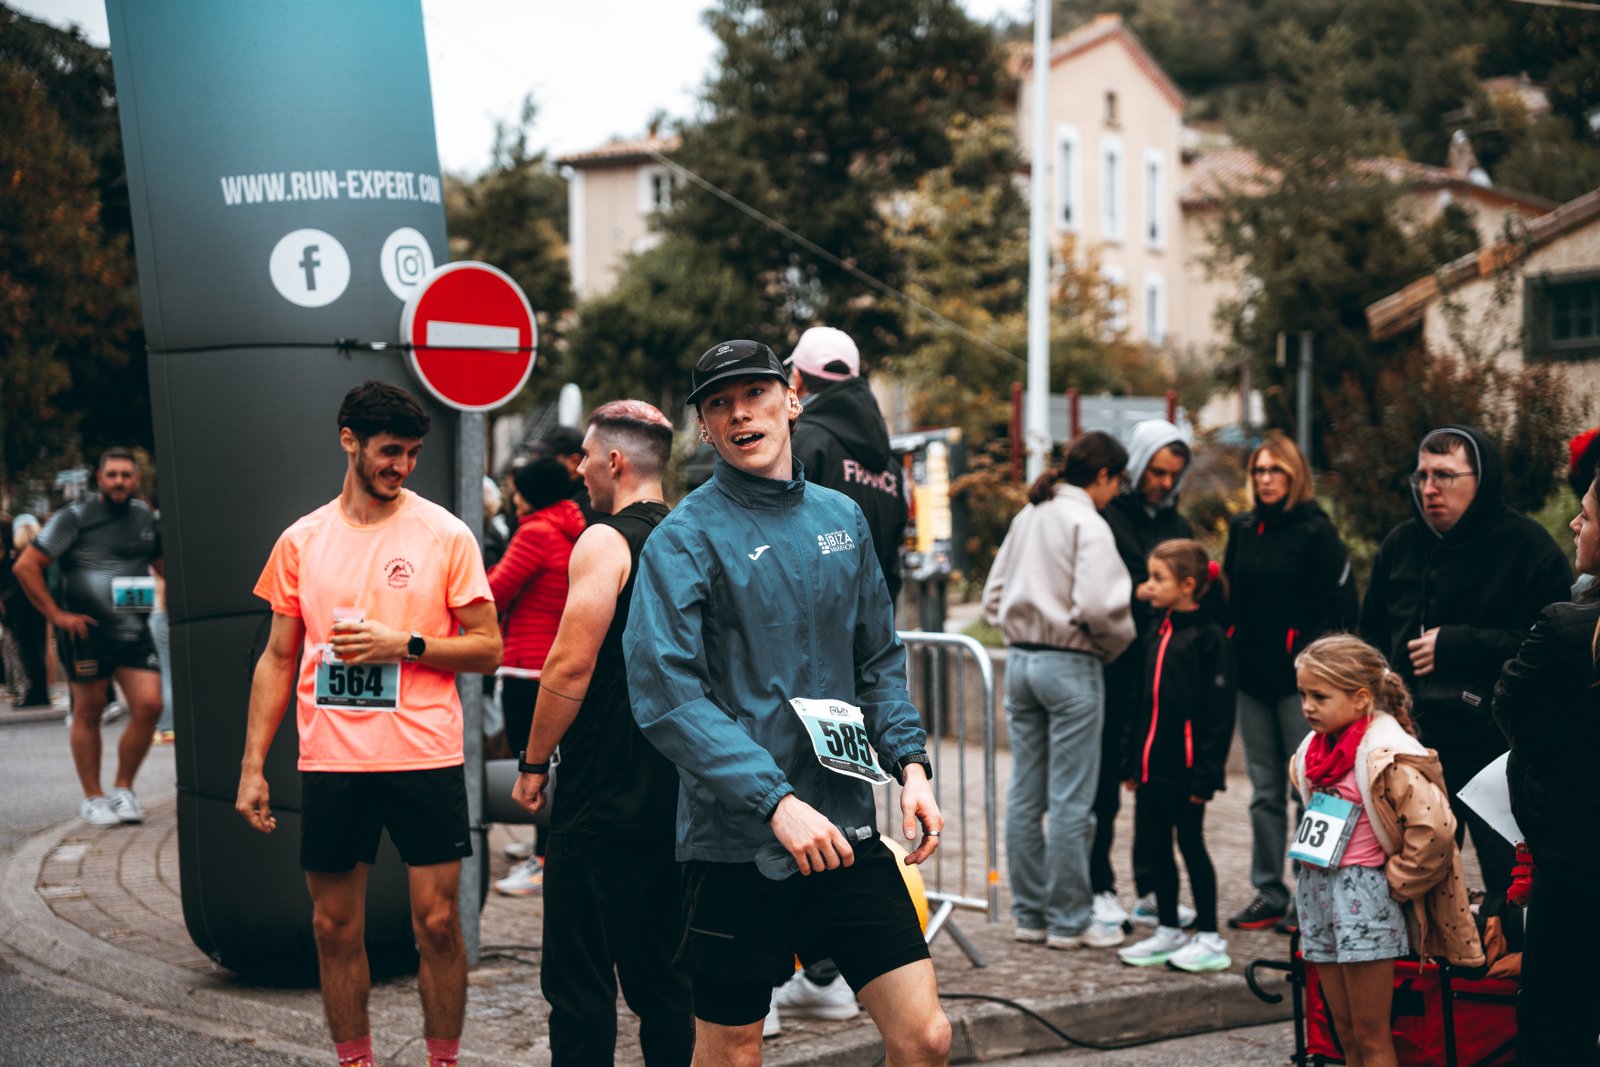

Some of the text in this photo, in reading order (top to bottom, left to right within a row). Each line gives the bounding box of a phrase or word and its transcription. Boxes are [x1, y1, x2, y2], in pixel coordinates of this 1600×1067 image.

[825, 532, 853, 547] IBIZA
[329, 664, 384, 697] 564
[817, 720, 873, 766] 585
[1295, 816, 1329, 848] 03
